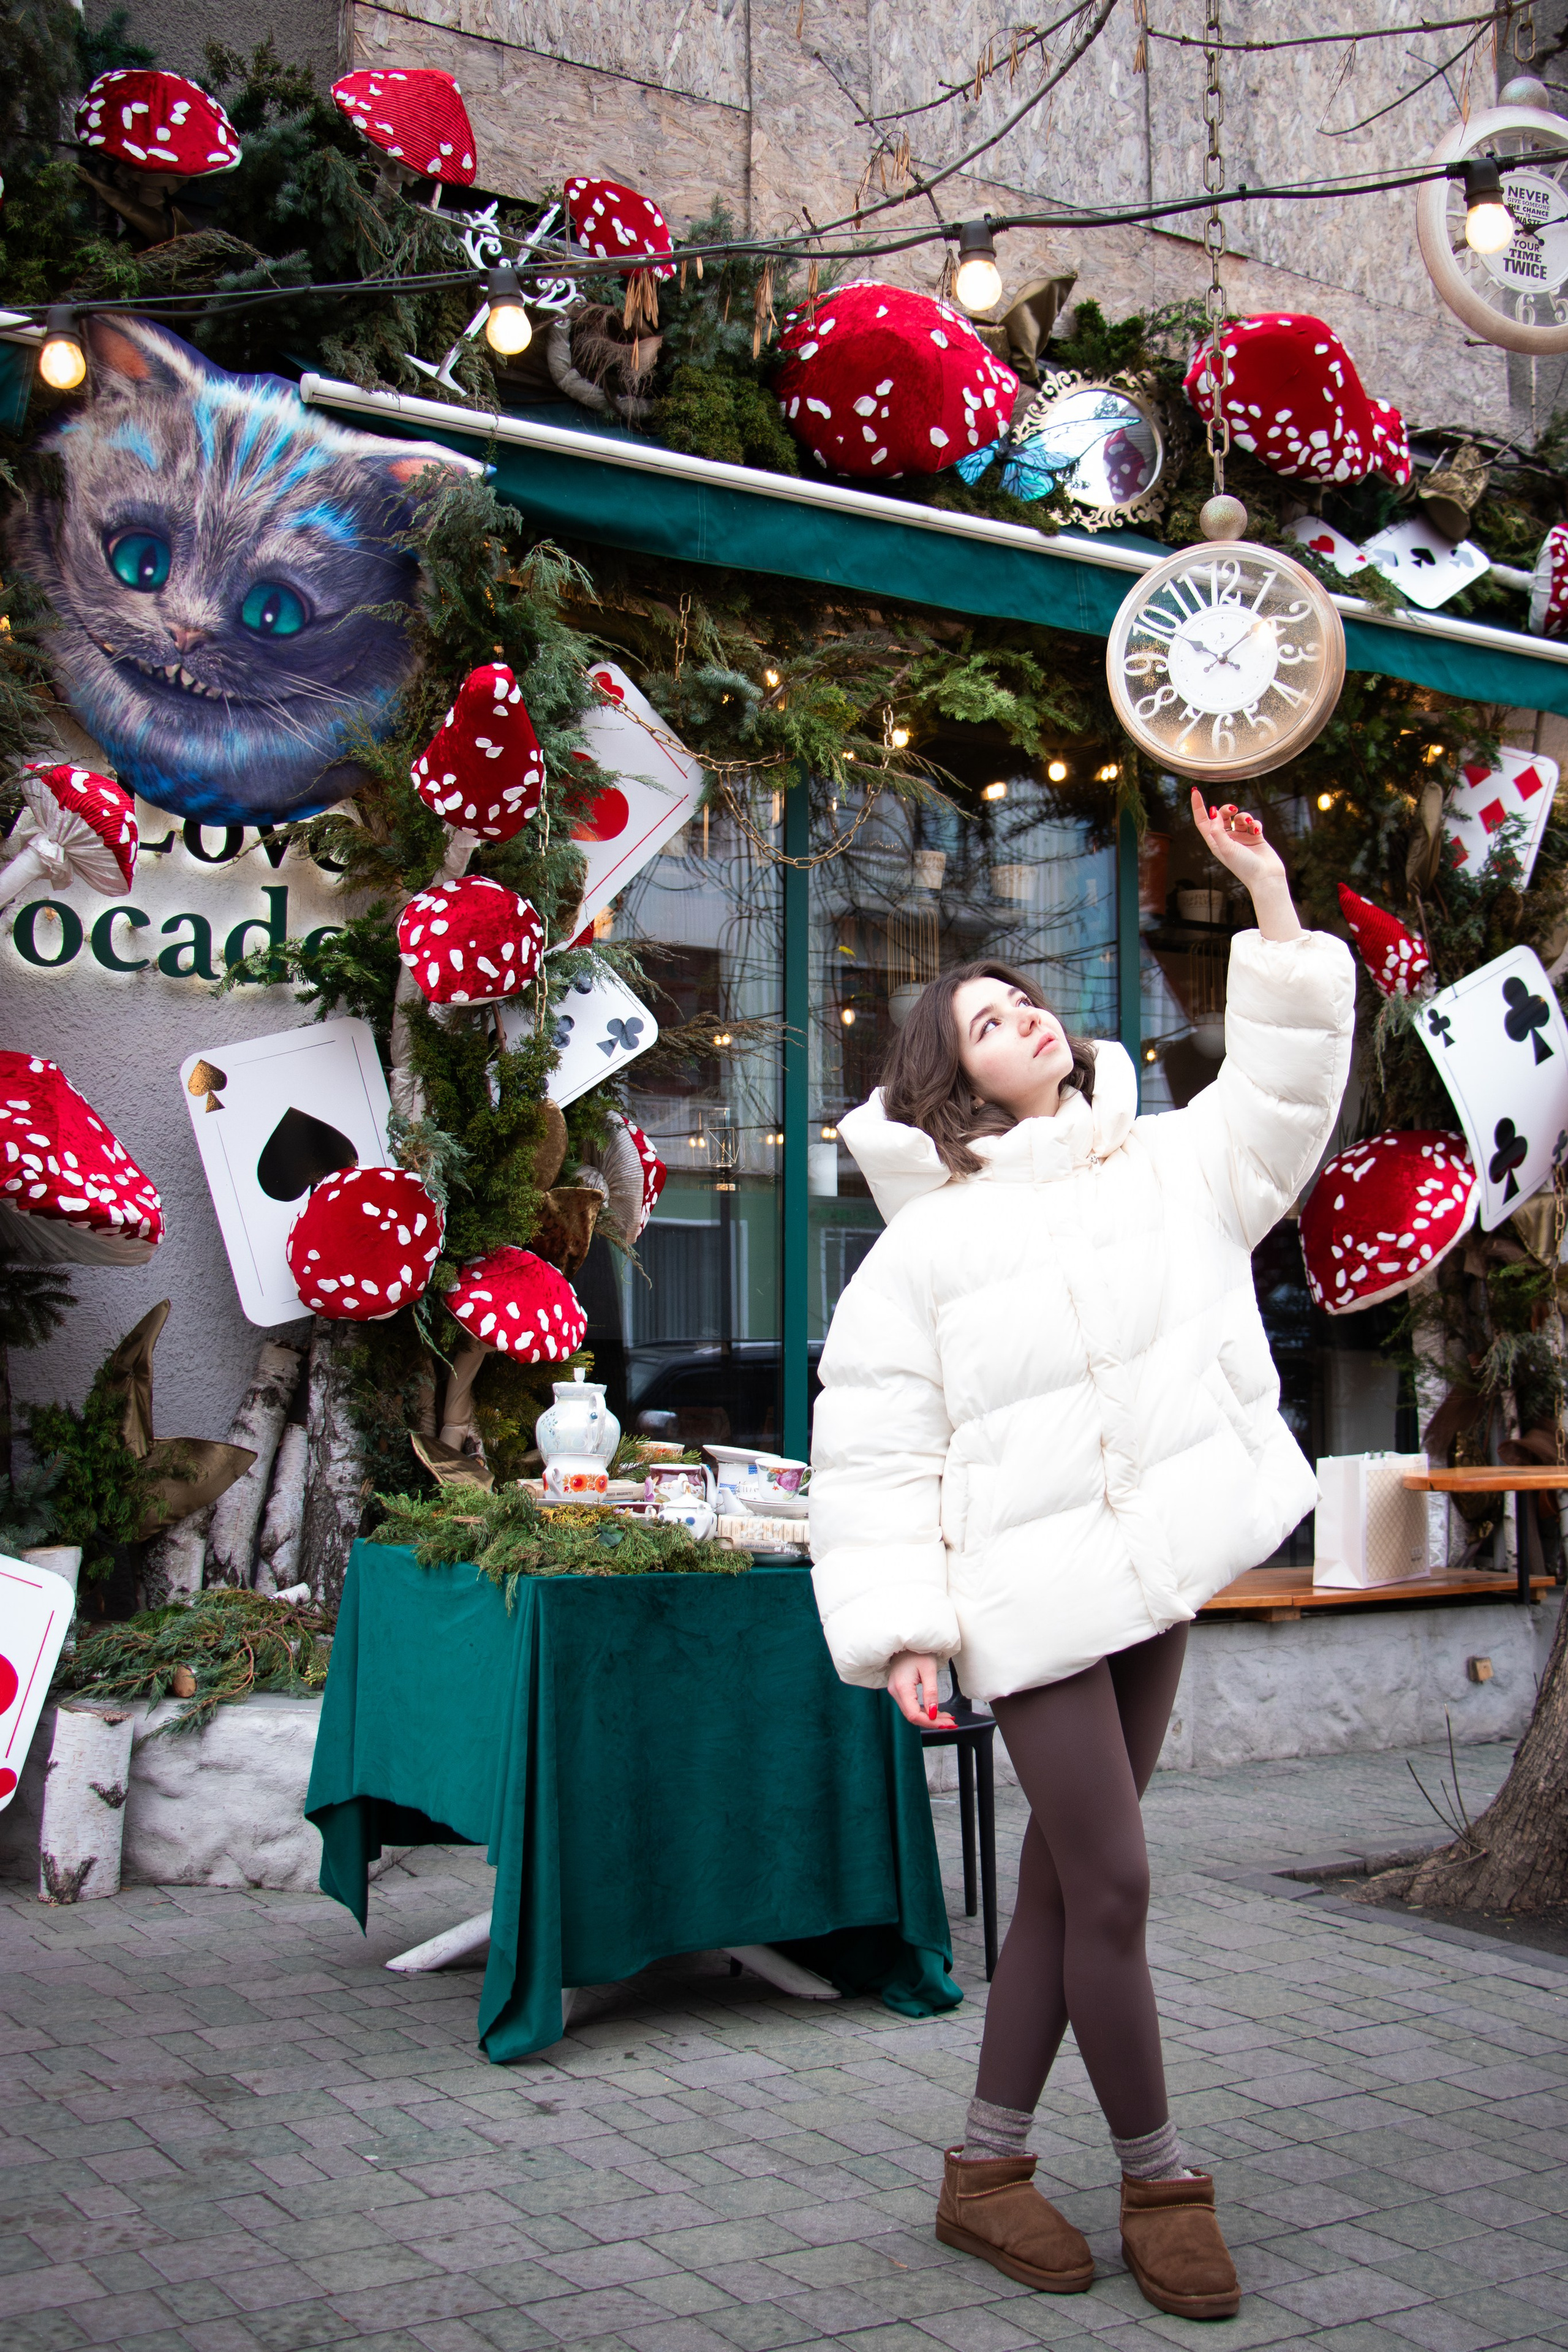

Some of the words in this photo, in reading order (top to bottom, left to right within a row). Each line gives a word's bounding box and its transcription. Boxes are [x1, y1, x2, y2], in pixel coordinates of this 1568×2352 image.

[1507, 186, 1549, 205] NEVER
[1522, 200, 1550, 211] SOMEONE
[1523, 206, 1549, 217] CHANCE
[1509, 248, 1542, 263] TIME
[1513, 239, 1540, 252] YOUR
[1502, 257, 1547, 280] TWICE
[1515, 292, 1536, 326] 6
[1162, 571, 1208, 619] 11
[1205, 558, 1242, 606] 12
[1253, 570, 1279, 613] 1
[1132, 604, 1183, 646] 10
[1123, 652, 1169, 676] 9
[1278, 643, 1324, 665] 3
[1134, 685, 1178, 720] 8
[1270, 678, 1314, 709] 4
[1173, 703, 1205, 753] 7
[1212, 713, 1237, 755] 6
